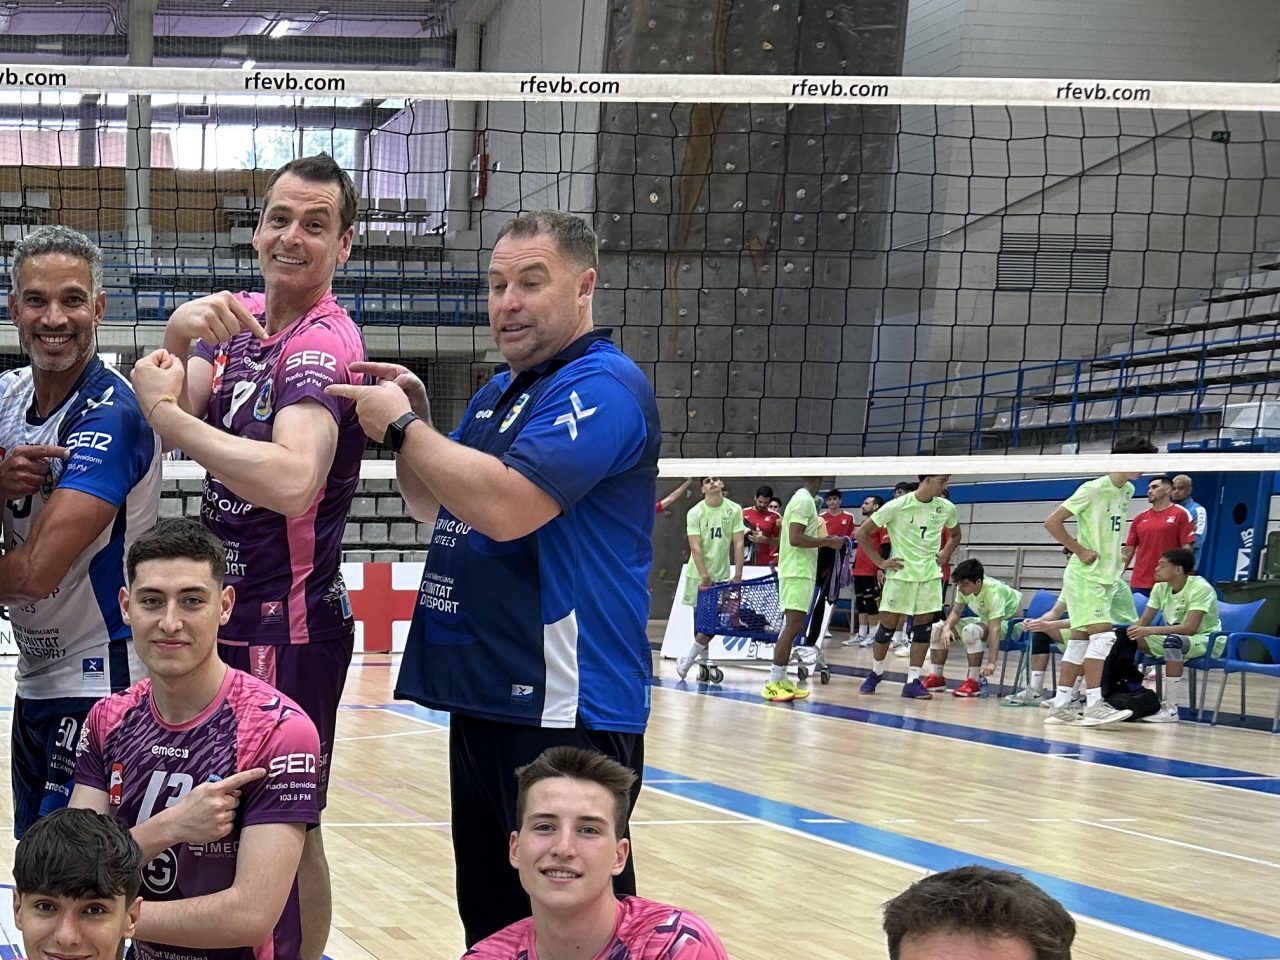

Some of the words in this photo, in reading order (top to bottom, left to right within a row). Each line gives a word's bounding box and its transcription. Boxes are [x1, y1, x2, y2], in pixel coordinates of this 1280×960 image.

[244, 72, 346, 92] rfevb.com
[519, 75, 621, 95] rfevb.com
[791, 78, 889, 99] rfevb.com
[1056, 82, 1151, 103] rfevb.com
[285, 350, 337, 372] SER
[285, 372, 303, 383] Radio
[305, 369, 334, 382] Benidorm
[66, 431, 113, 452] SER
[710, 527, 722, 539] 14
[920, 527, 927, 539] 7
[1111, 516, 1121, 531] 15
[268, 753, 316, 777] SER
[280, 793, 298, 801] 103.8
[299, 793, 311, 801] FM
